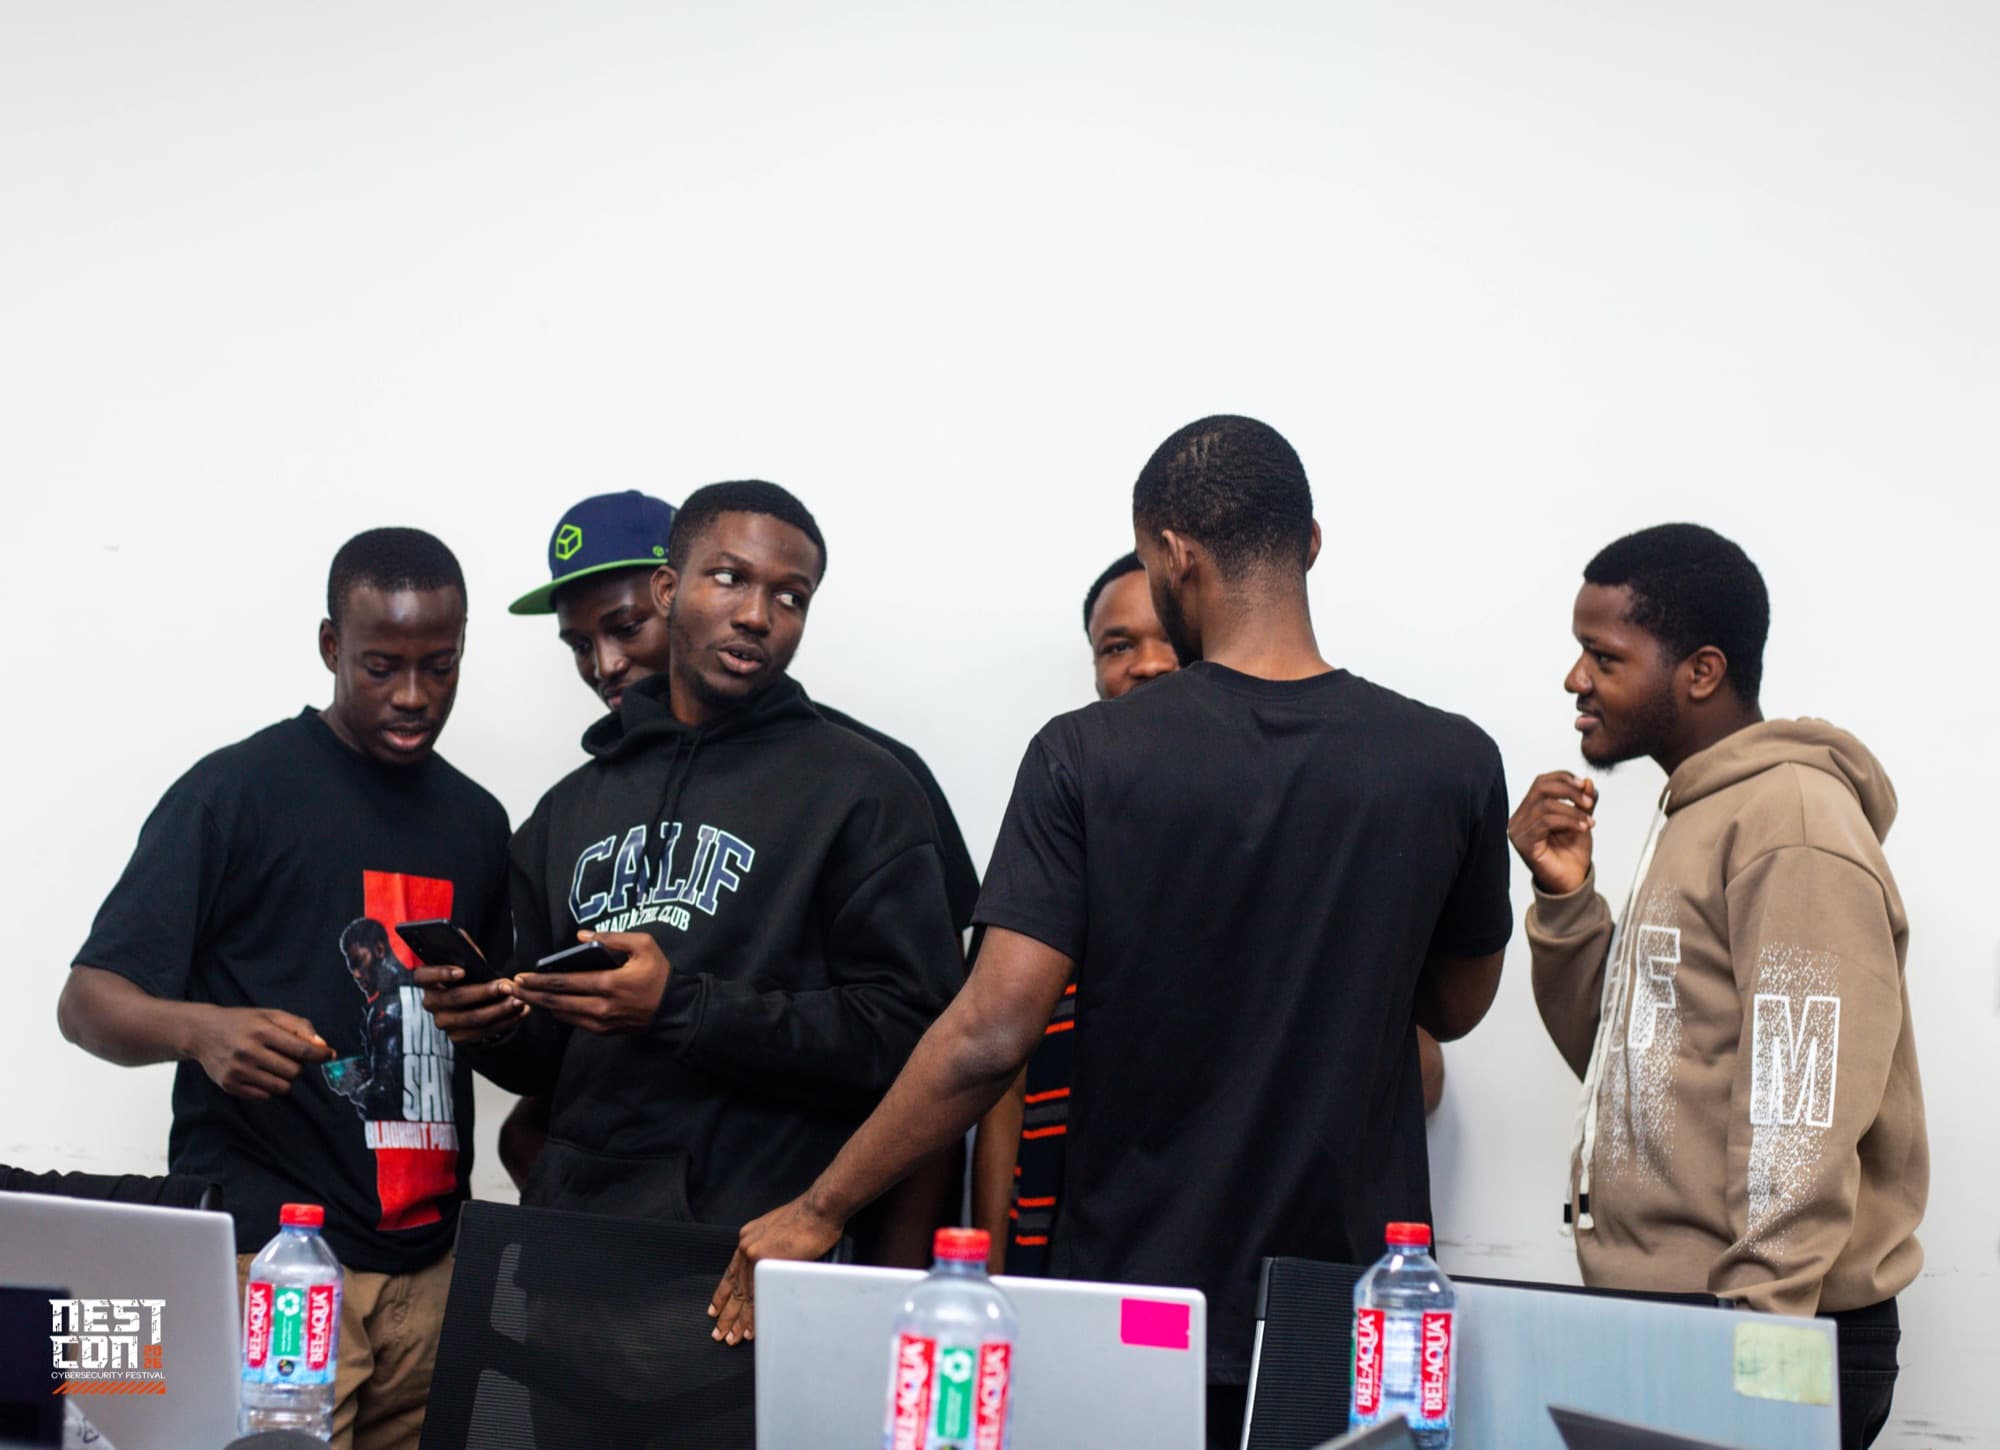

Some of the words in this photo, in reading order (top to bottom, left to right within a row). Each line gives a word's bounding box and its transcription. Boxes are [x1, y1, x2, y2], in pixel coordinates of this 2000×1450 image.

[569, 822, 755, 924] CALIF
[1750, 994, 1841, 1128] M
[248, 1288, 267, 1361] BEL-AQUA
[310, 1290, 329, 1363] BEL-AQUA
[1357, 1312, 1379, 1408] BEL-AQUA
[1424, 1317, 1448, 1411] BEL-AQUA
